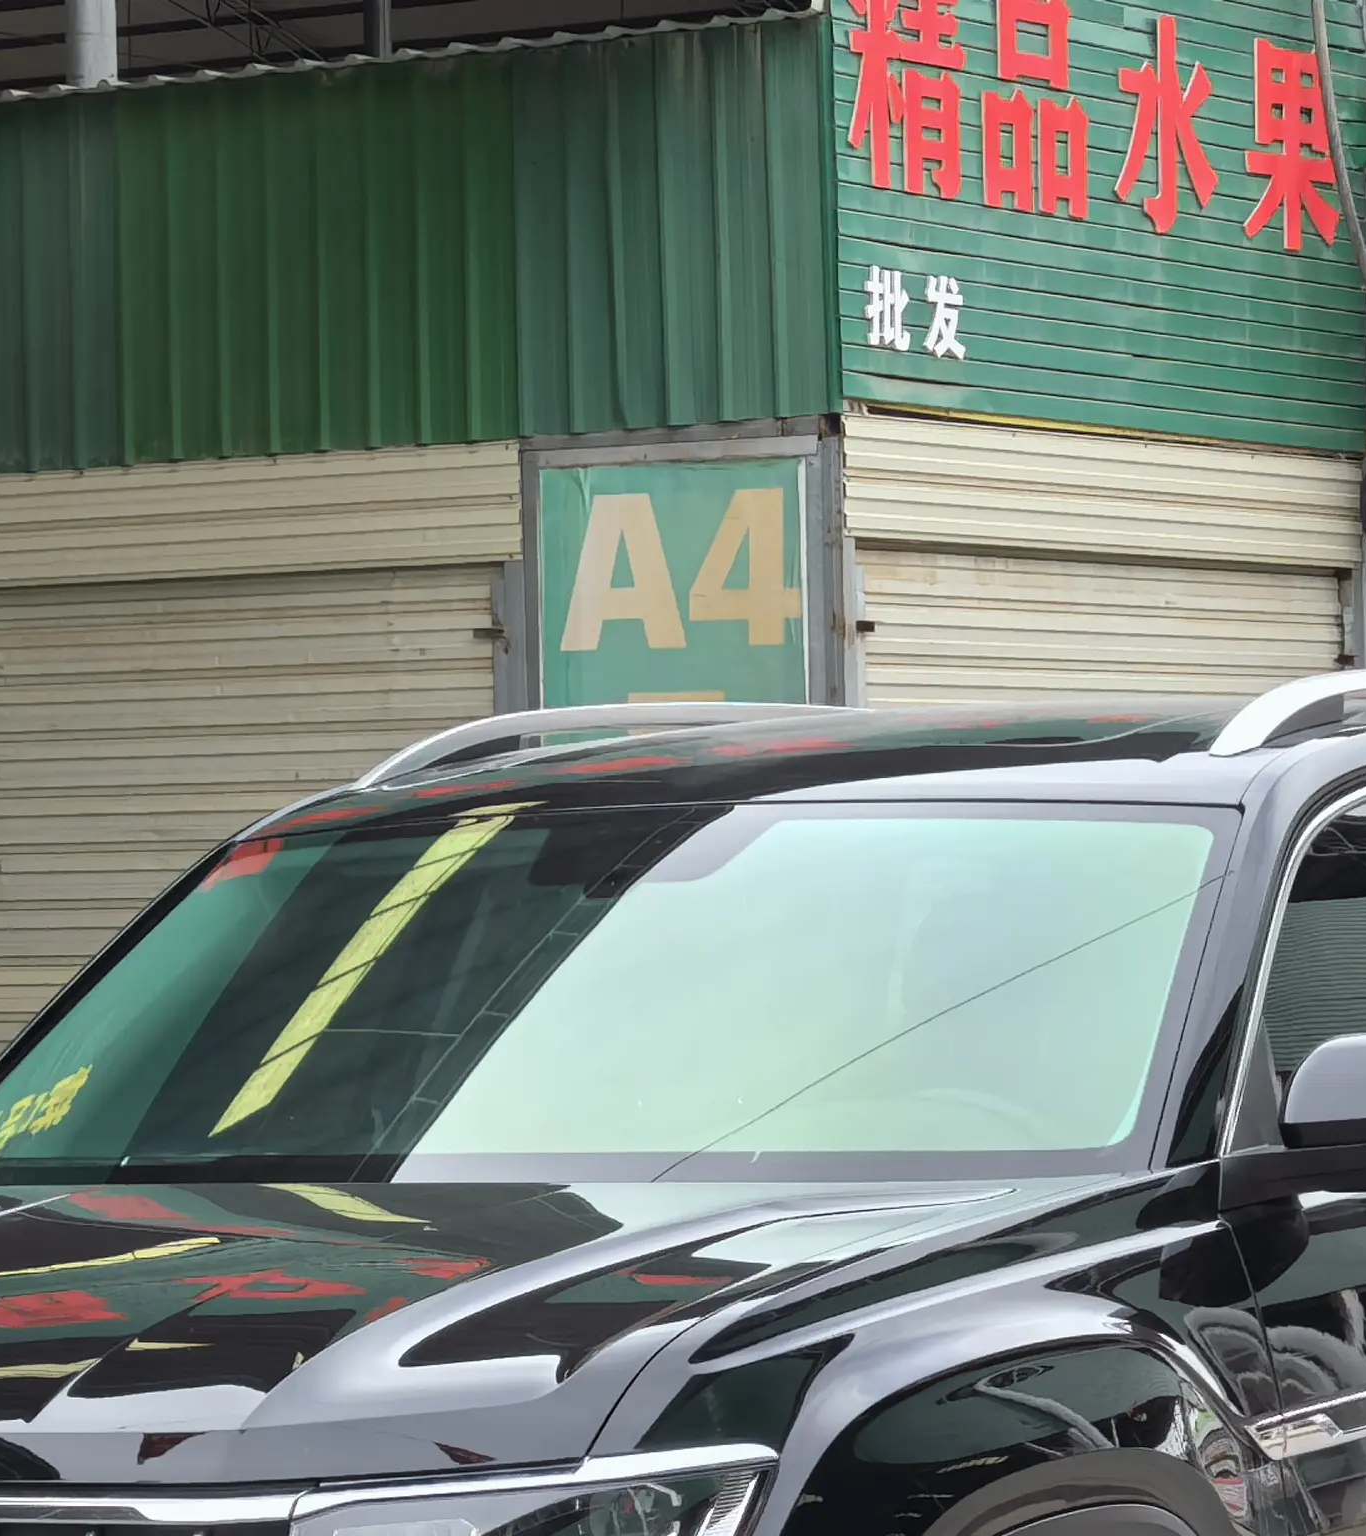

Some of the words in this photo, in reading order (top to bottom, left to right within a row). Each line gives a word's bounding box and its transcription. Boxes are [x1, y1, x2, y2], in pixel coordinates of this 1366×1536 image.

[847, 0, 1339, 251] 精品水果
[863, 265, 966, 360] 批发
[560, 487, 802, 652] A4
